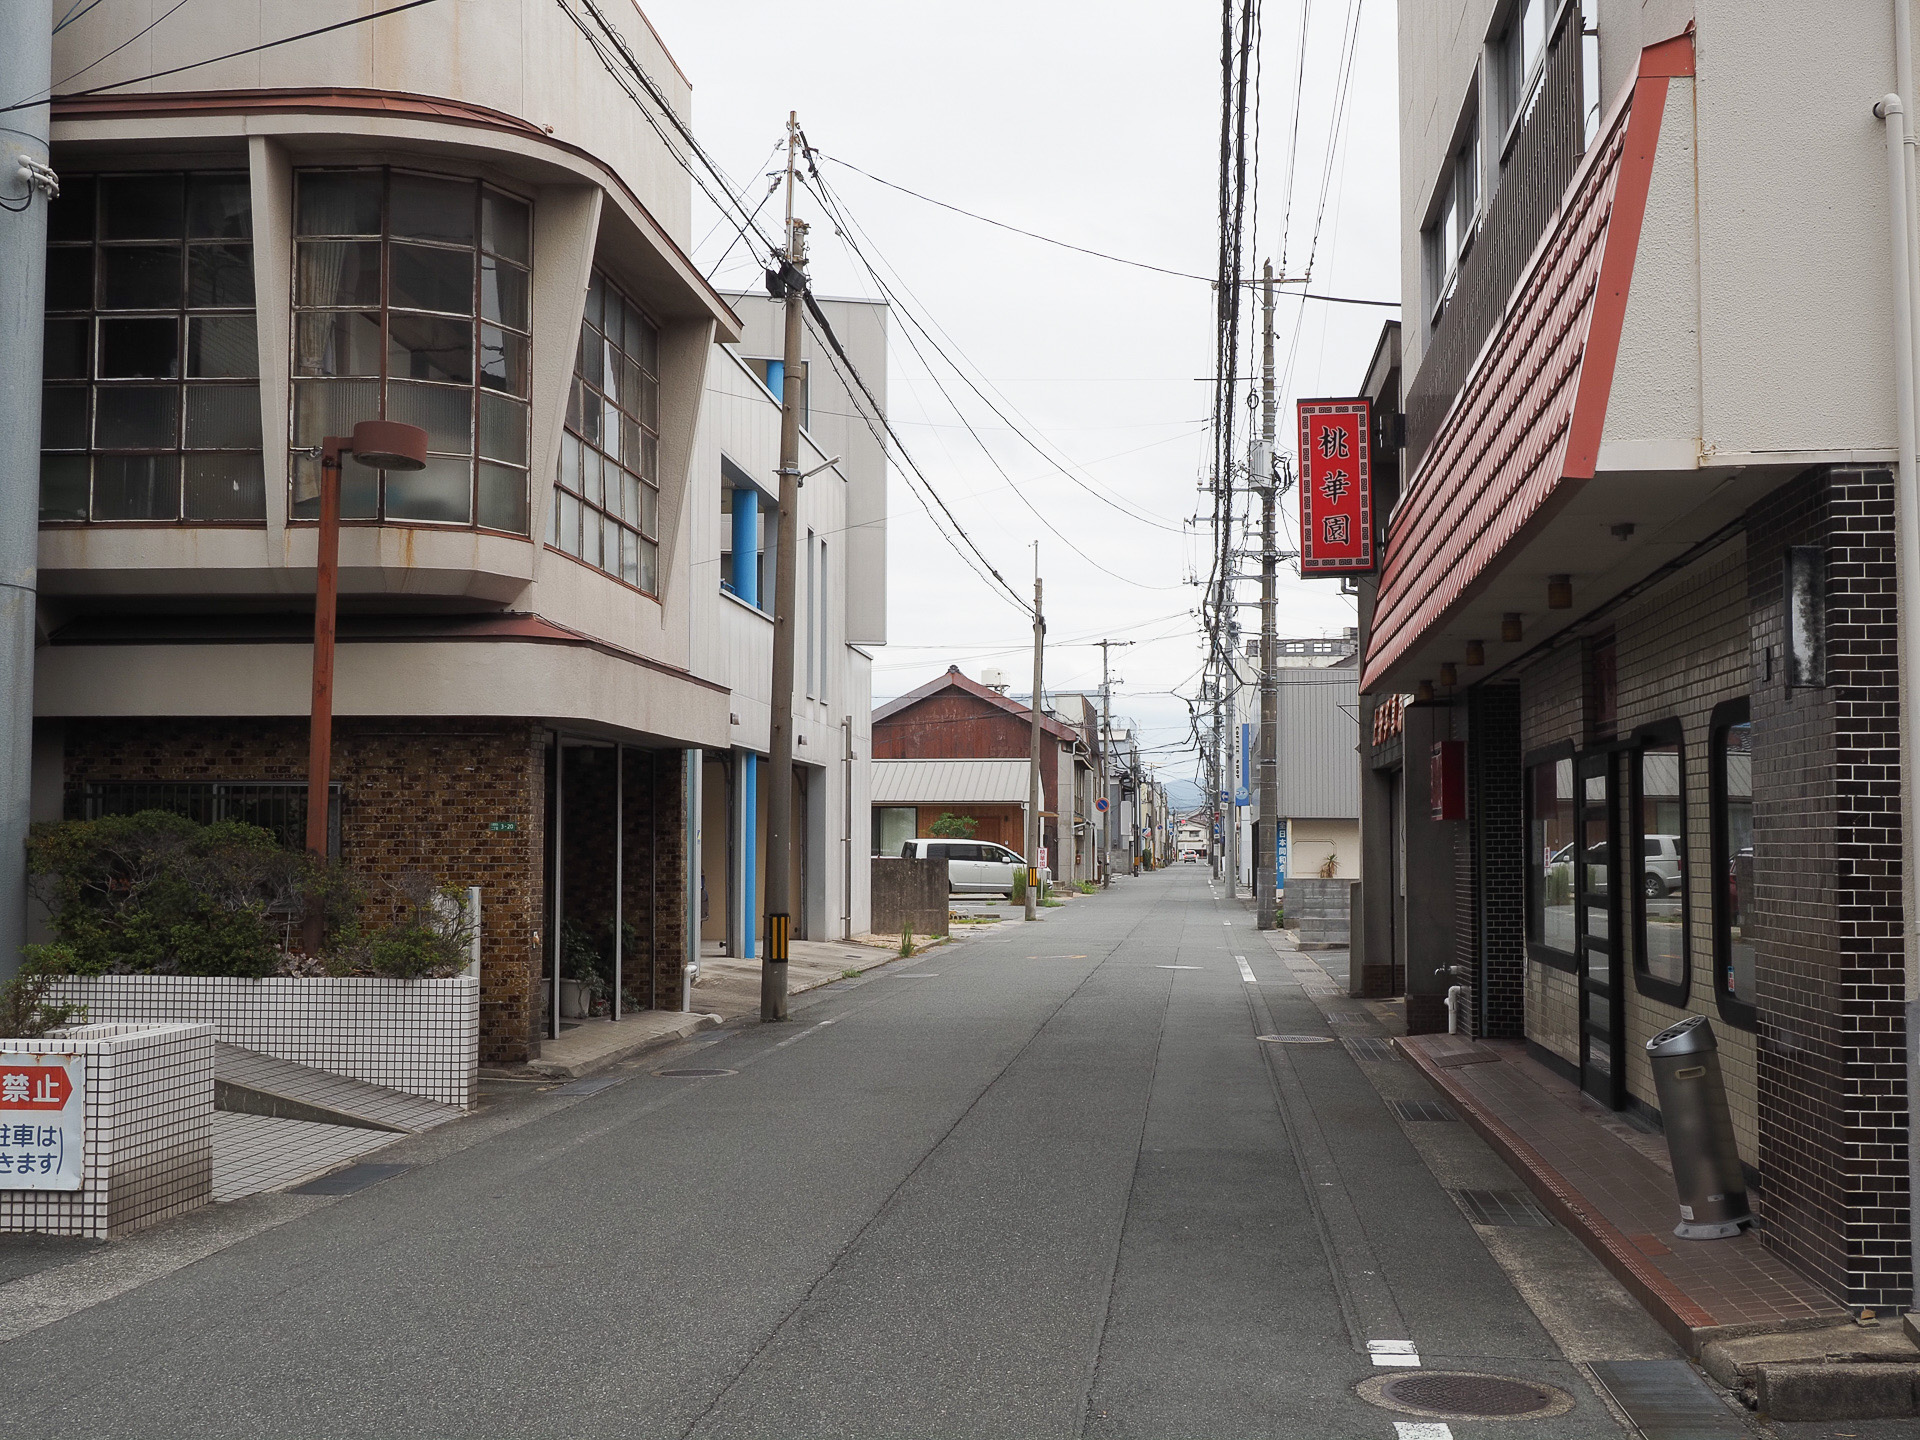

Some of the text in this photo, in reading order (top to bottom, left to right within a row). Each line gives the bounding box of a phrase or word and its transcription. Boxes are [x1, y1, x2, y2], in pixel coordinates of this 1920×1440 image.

[1317, 425, 1352, 546] 桃華園
[1278, 821, 1287, 873] 全日本同和会
[1, 1073, 61, 1102] 禁止
